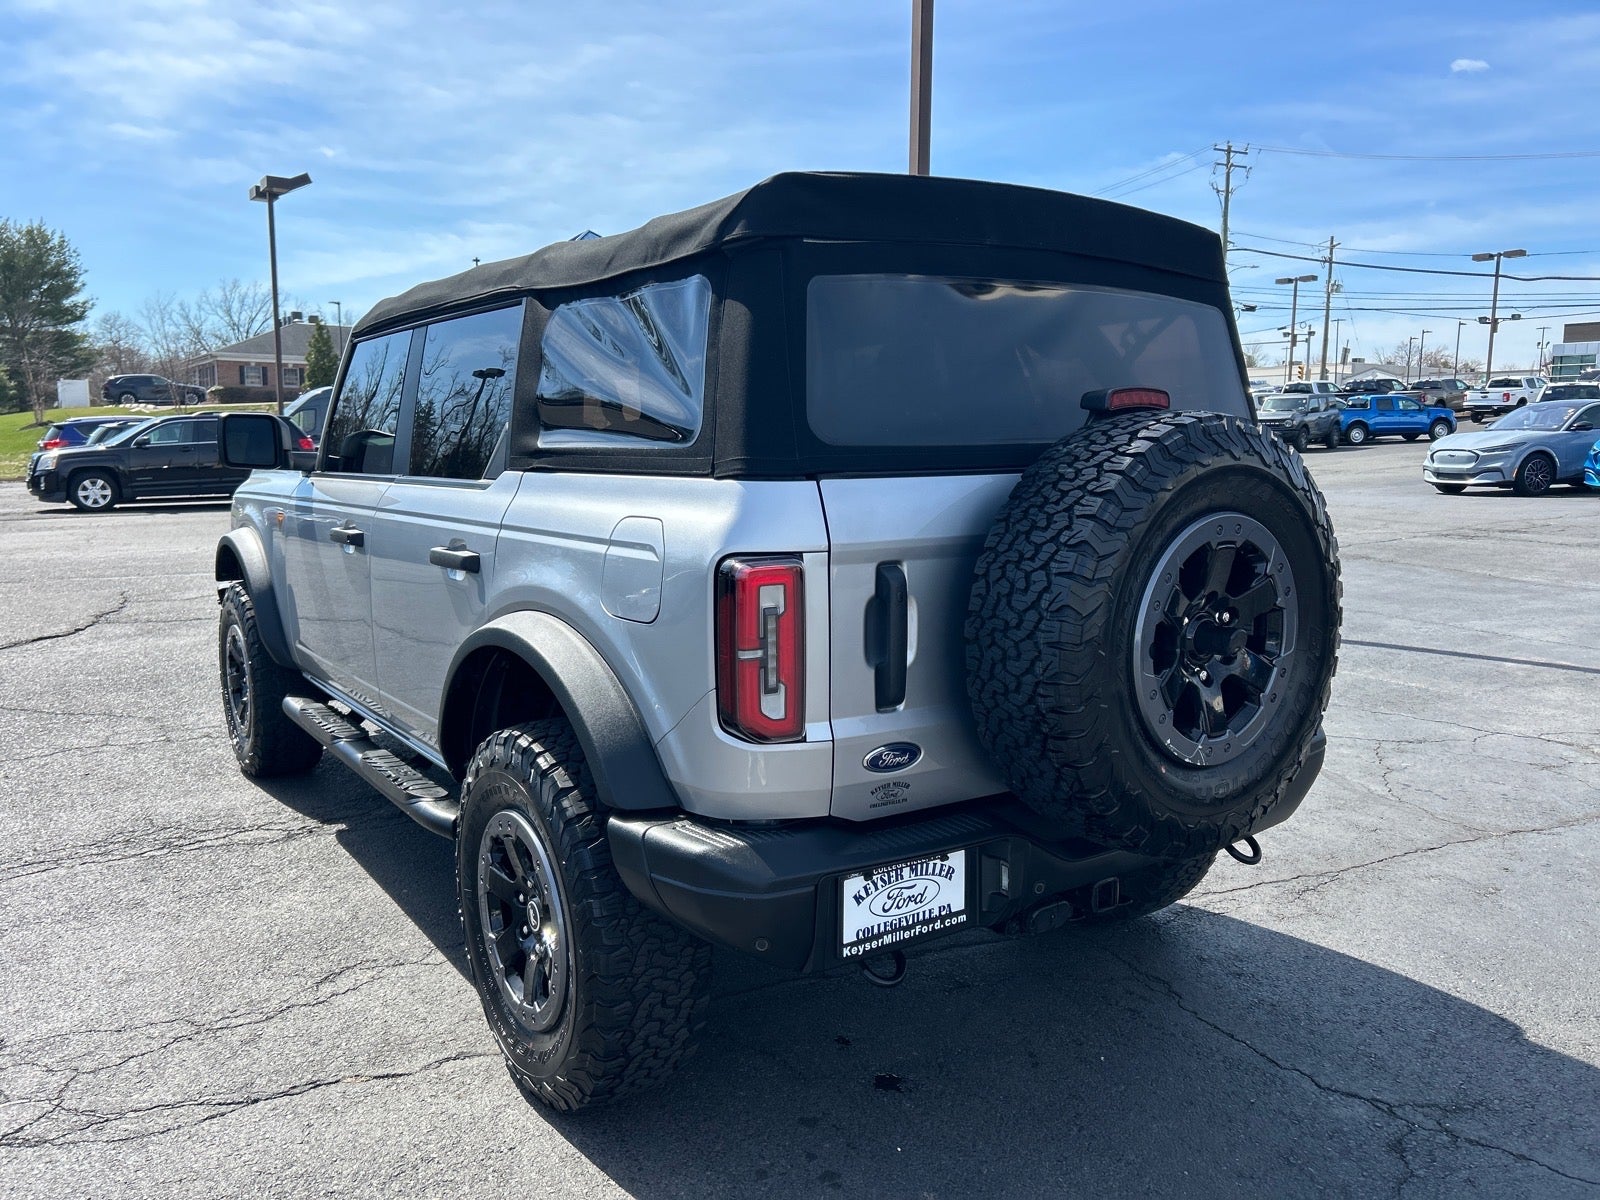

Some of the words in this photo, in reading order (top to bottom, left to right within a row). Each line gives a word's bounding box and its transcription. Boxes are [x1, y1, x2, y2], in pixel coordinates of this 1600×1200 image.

[879, 751, 910, 768] Ford
[892, 781, 912, 790] MILLER
[852, 867, 905, 907] KEYSER
[908, 861, 956, 882] MILLER
[881, 883, 929, 914] Ford
[842, 914, 967, 958] KeyserMillerFord.com
